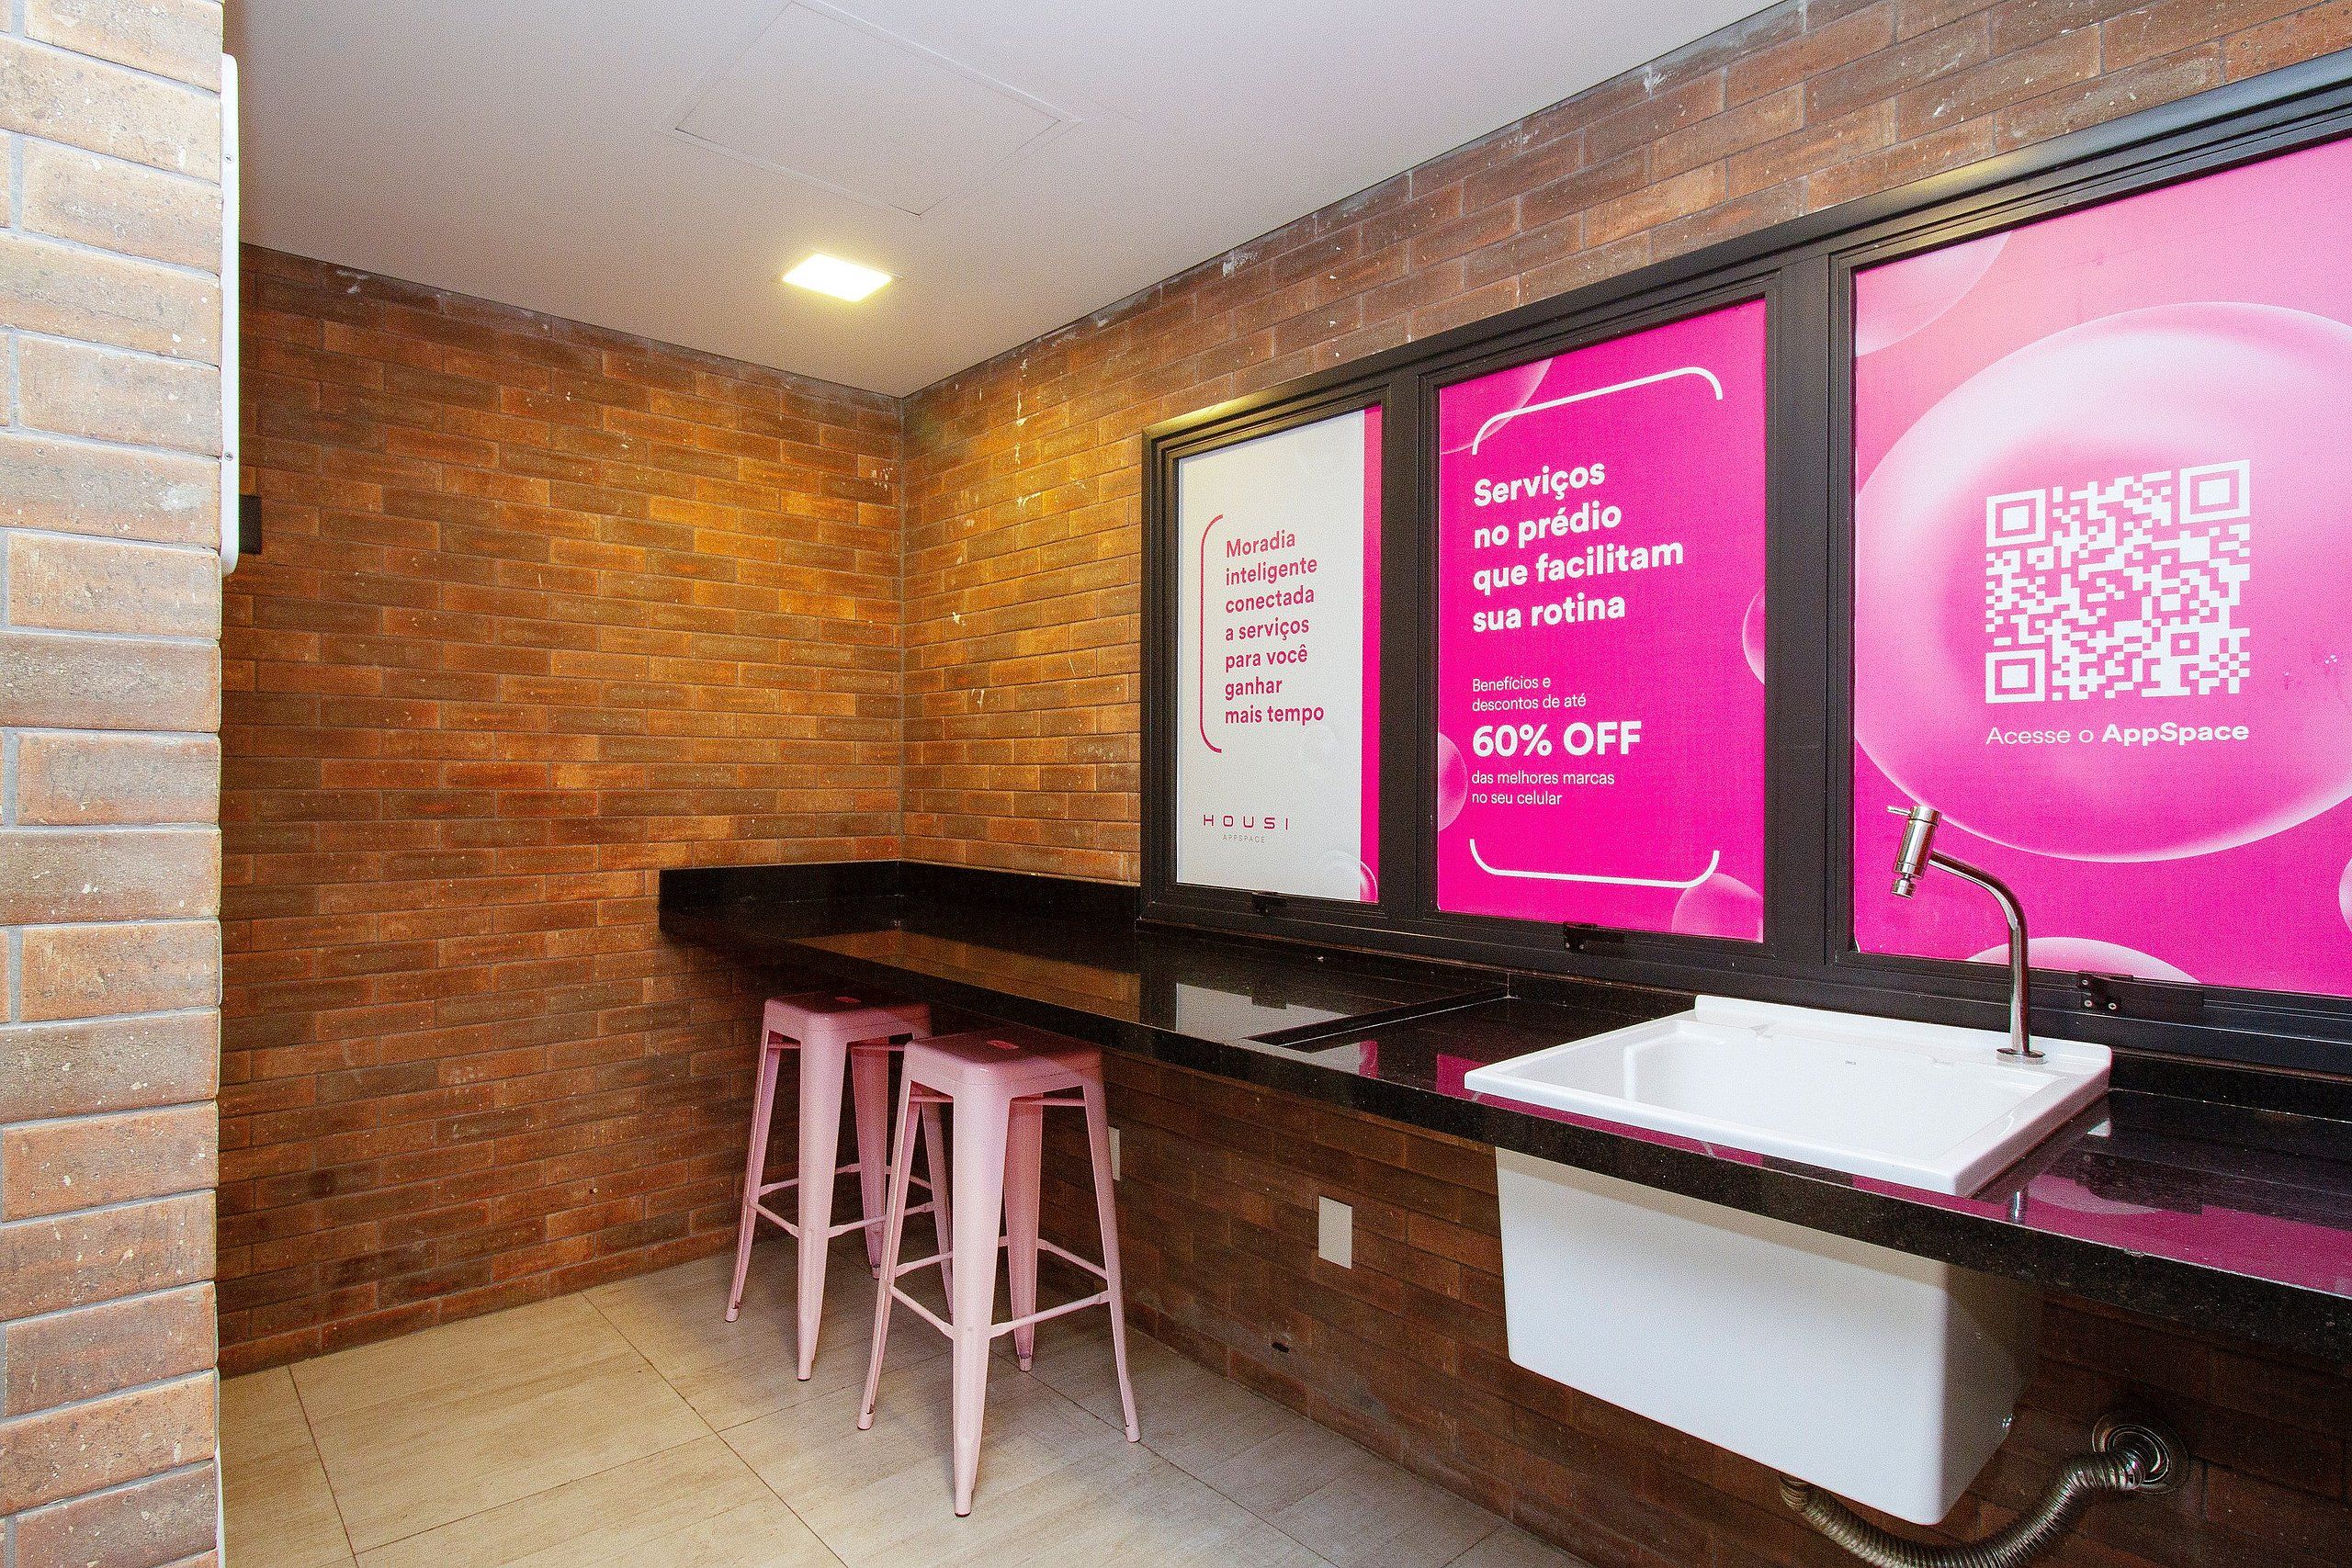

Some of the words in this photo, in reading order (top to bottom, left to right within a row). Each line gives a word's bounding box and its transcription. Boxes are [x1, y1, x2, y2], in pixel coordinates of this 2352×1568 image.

[1473, 462, 1606, 507] Serviços
[1474, 525, 1510, 549] no
[1519, 501, 1623, 549] prédio
[1226, 529, 1296, 558] Moradia
[1226, 558, 1317, 587] inteligente
[1473, 564, 1528, 597] que
[1536, 542, 1684, 582] facilitam
[1225, 585, 1315, 614] conectada
[1473, 607, 1521, 632] sua
[1531, 592, 1625, 626] rotina
[1226, 626, 1234, 641] a
[1238, 617, 1310, 640] serviços
[1225, 652, 1261, 672] para
[1266, 644, 1308, 666] você
[1225, 677, 1283, 700] ganhar
[1472, 676, 1539, 693] Benefícios
[1542, 678, 1551, 688] e
[1472, 696, 1539, 712] descontos
[1543, 694, 1560, 708] de
[1564, 693, 1587, 708] até
[1225, 705, 1263, 724] mais
[1267, 705, 1325, 726] tempo
[1472, 723, 1553, 757] 60%
[1563, 721, 1642, 756] OFF
[1986, 726, 2071, 745] Acesse
[2078, 729, 2094, 743] o
[2102, 722, 2249, 746] AppSpace
[1471, 770, 1494, 784] das
[1497, 770, 1559, 784] melhores
[1563, 773, 1615, 785] marcas
[1472, 793, 1487, 804] no
[1490, 793, 1513, 805] seu
[1517, 790, 1563, 806] celular
[1203, 814, 1288, 830] HOUSI
[1222, 834, 1265, 843] APPSPACE
